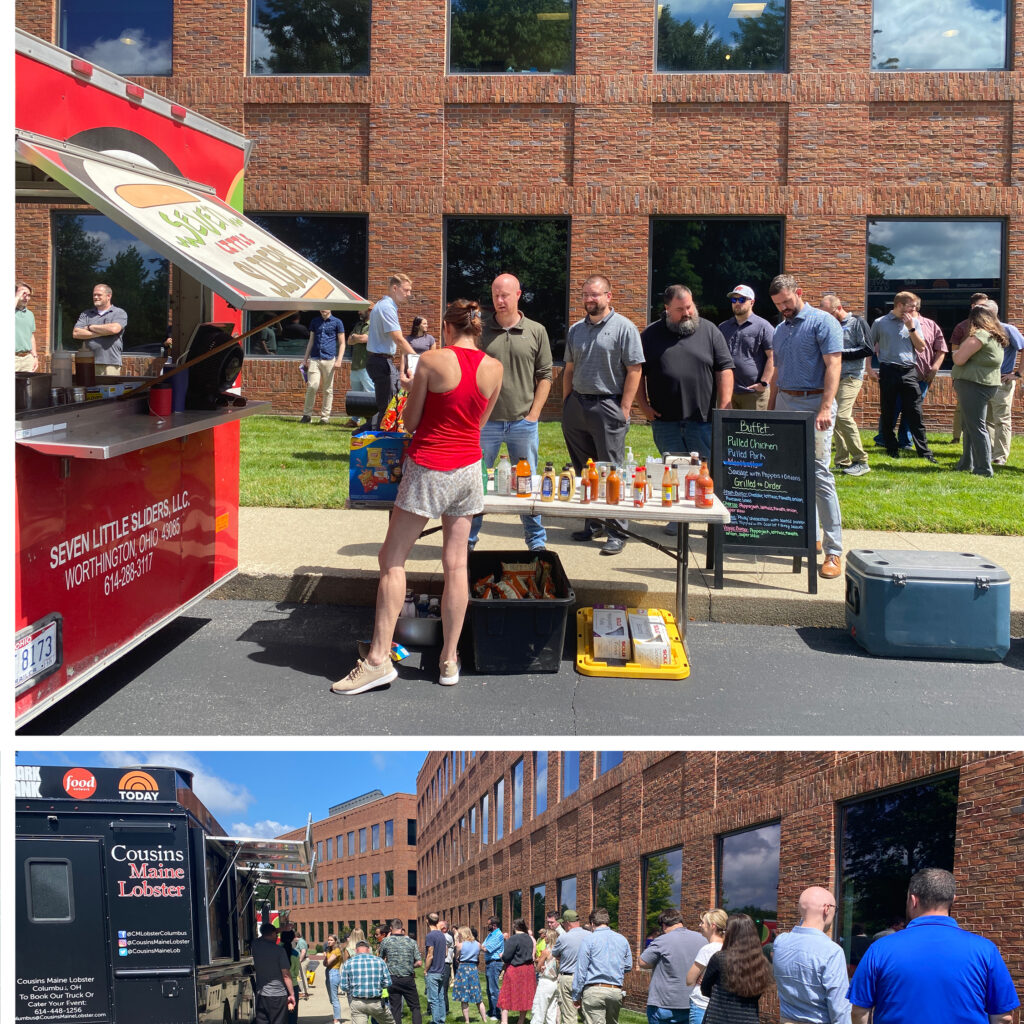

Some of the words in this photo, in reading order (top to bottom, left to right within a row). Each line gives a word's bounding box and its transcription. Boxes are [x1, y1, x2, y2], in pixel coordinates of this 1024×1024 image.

[740, 420, 770, 434] Buffet
[727, 435, 749, 448] Pulled
[749, 438, 778, 451] Chicken
[727, 448, 747, 459] Pulled
[733, 477, 756, 488] Grilled
[49, 528, 89, 569] SEVEN
[92, 516, 129, 549] LITTLE
[131, 499, 171, 532] SLIDERS,
[172, 490, 190, 514] LLC.
[65, 539, 138, 590] WORTHINGTON,
[139, 527, 159, 550] OHIO
[161, 517, 181, 540] 43085
[104, 551, 153, 596] 614-288-3117
[21, 635, 52, 671] 8173
[65, 775, 95, 791] food
[118, 791, 159, 800] TODAY
[111, 844, 184, 862] Cousins
[127, 862, 185, 879] Maine
[117, 880, 185, 897] Lobster
[34, 1007, 82, 1015] 614-448-1256
